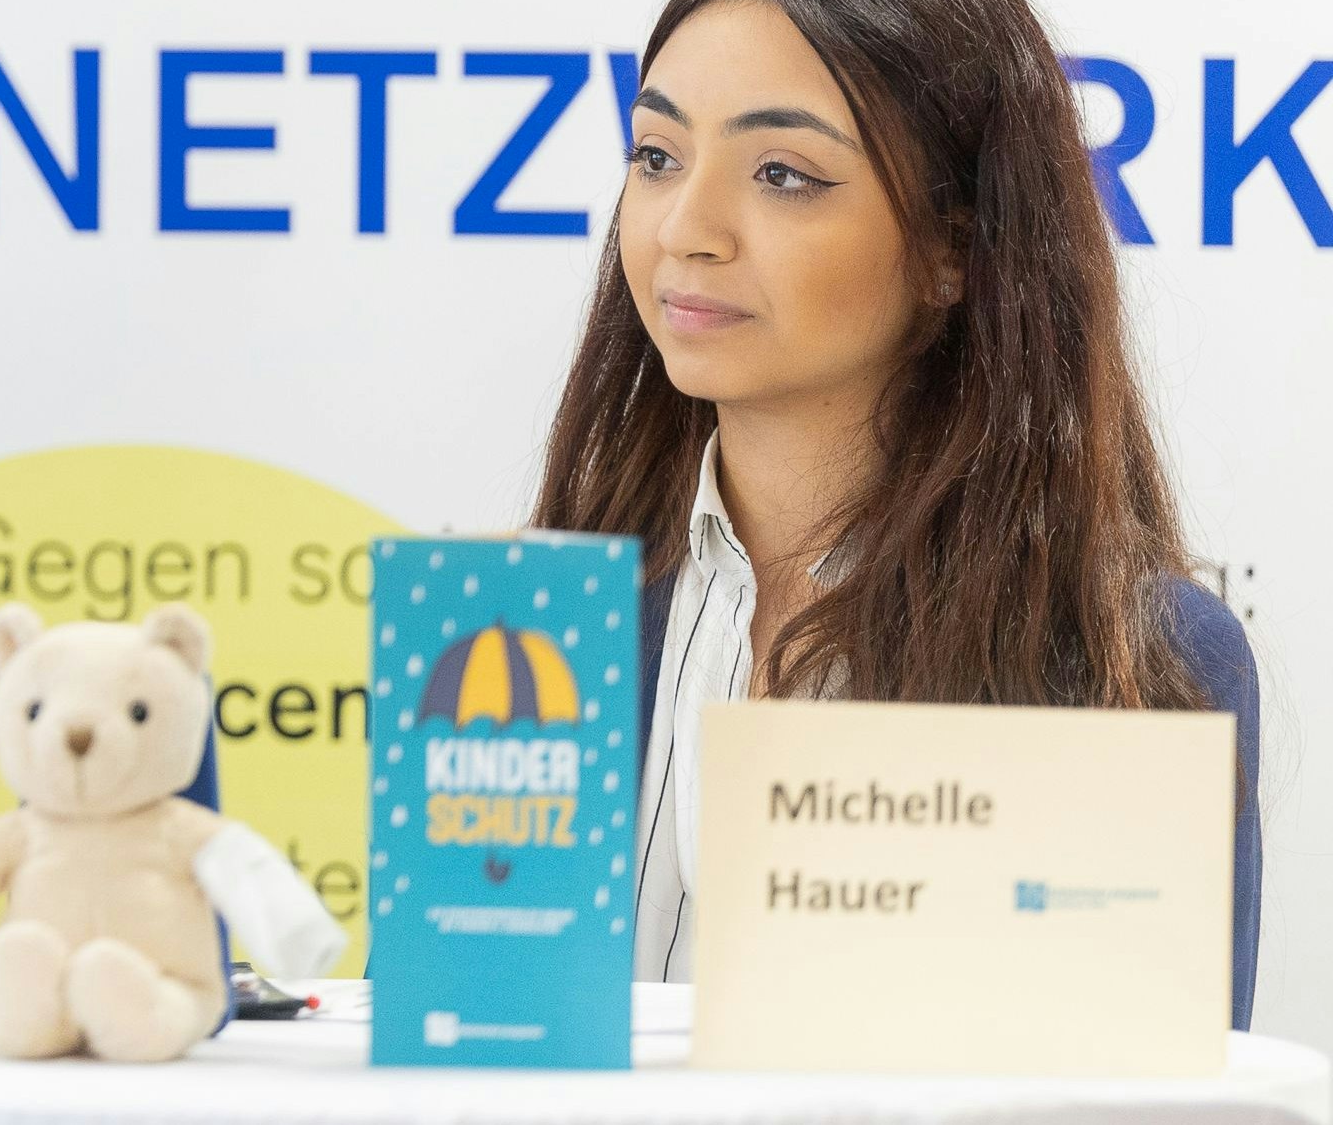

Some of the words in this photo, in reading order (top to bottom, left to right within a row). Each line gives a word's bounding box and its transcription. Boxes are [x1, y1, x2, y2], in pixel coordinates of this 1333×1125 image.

[427, 740, 578, 792] KINDER
[427, 793, 577, 848] SCHUTZ
[768, 779, 994, 826] Michelle
[766, 870, 926, 912] Hauer
